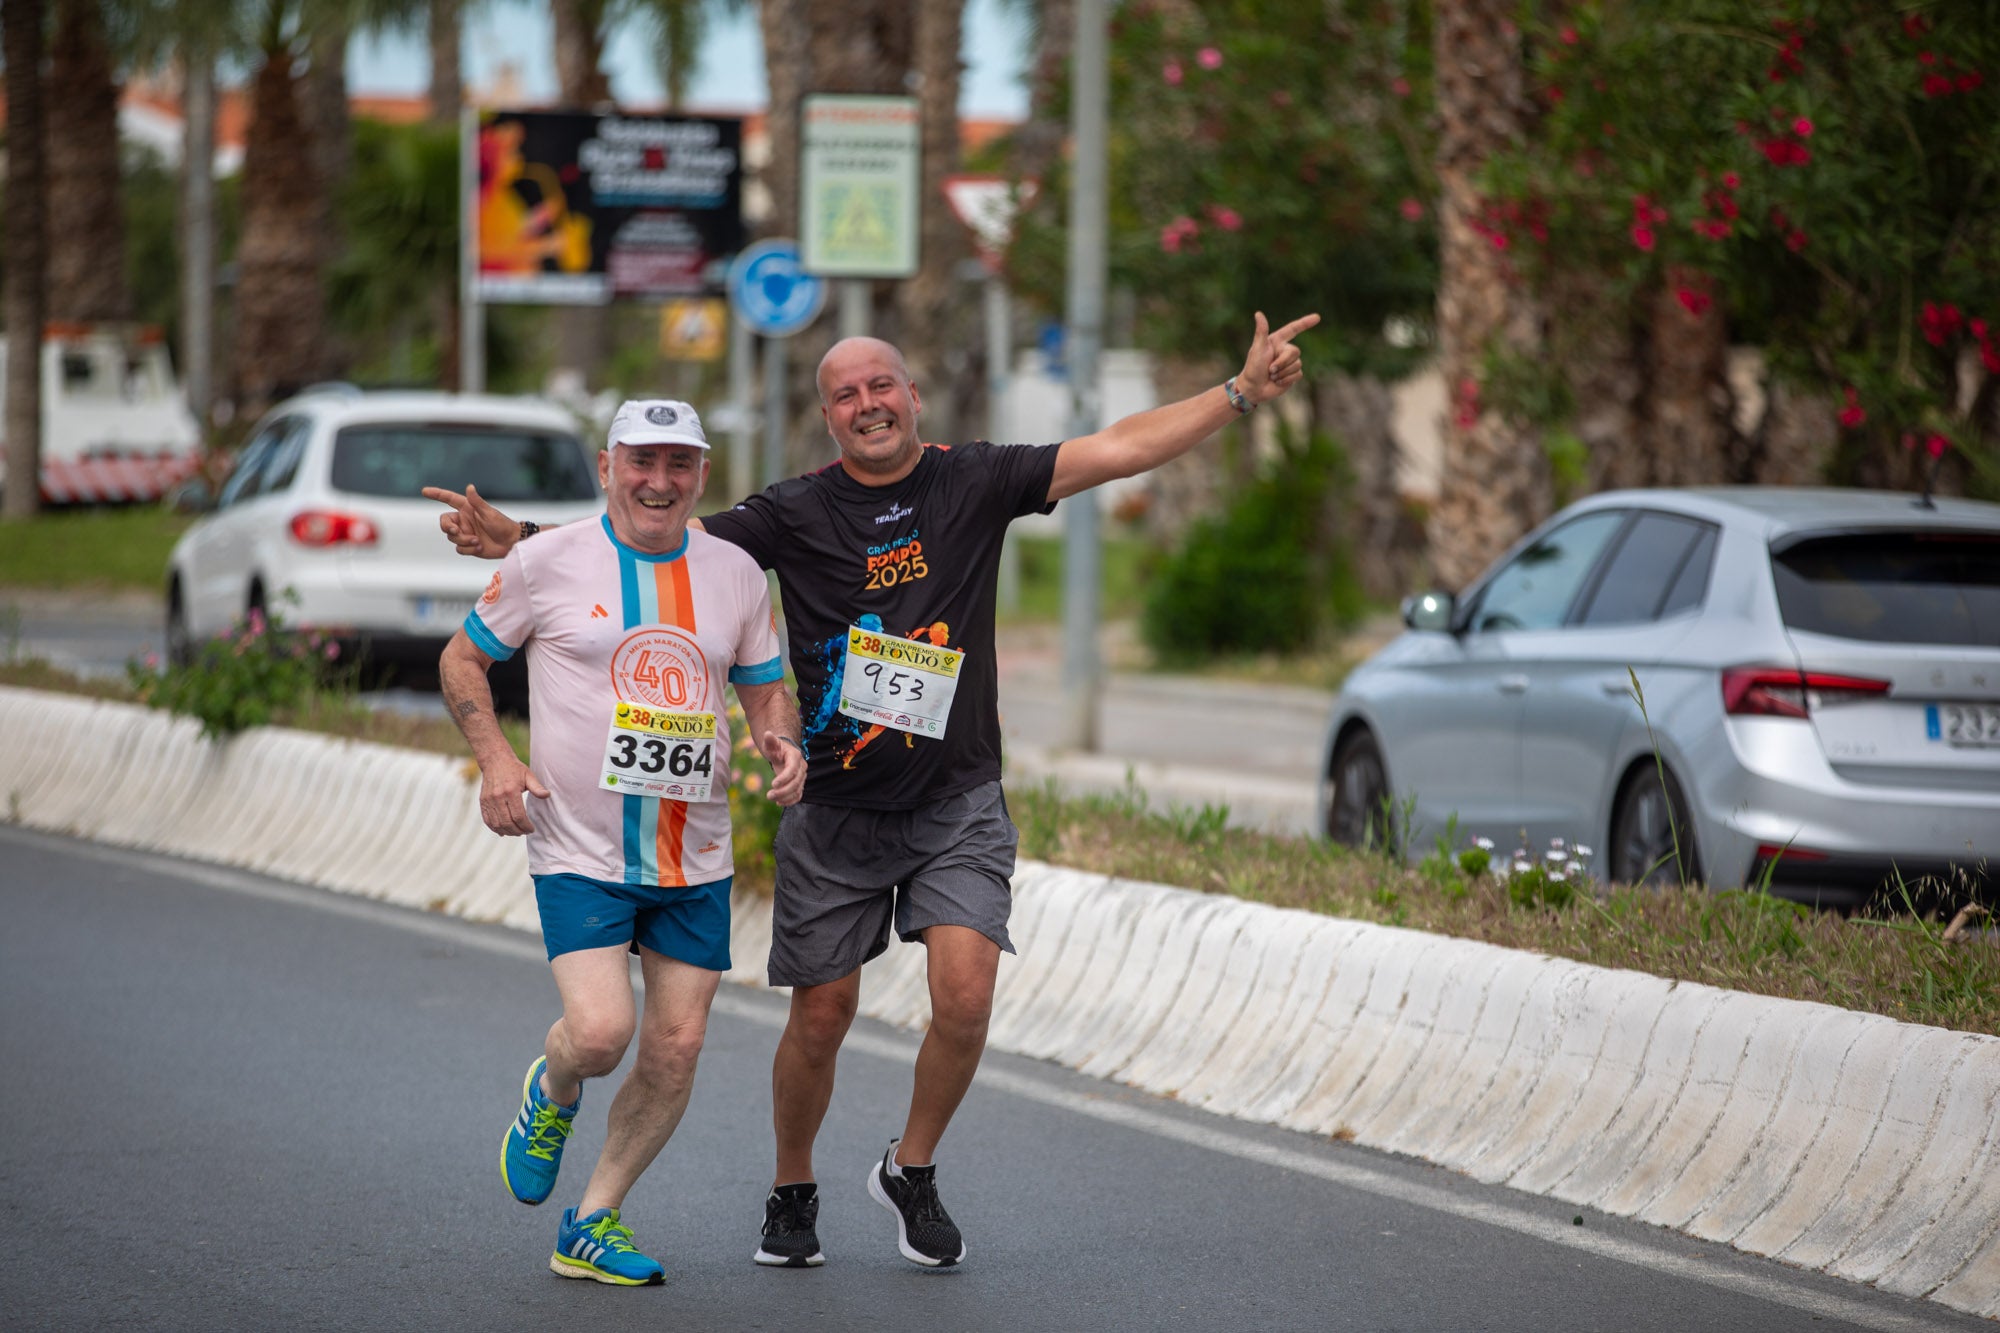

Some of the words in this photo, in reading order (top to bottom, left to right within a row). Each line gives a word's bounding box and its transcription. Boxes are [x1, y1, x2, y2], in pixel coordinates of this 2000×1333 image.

[867, 543, 891, 555] GRAN
[867, 540, 922, 572] FONDO
[864, 555, 929, 590] 2025
[628, 639, 652, 655] MEDIA
[861, 636, 881, 653] 38
[885, 640, 907, 650] GRAN
[907, 645, 935, 657] PREMIO
[880, 645, 939, 667] FONDO
[633, 650, 687, 706] 40
[864, 662, 924, 701] 953
[630, 709, 651, 726] 38
[650, 717, 703, 733] FONDO
[655, 712, 676, 721] GRAN
[610, 734, 712, 778] 3364
